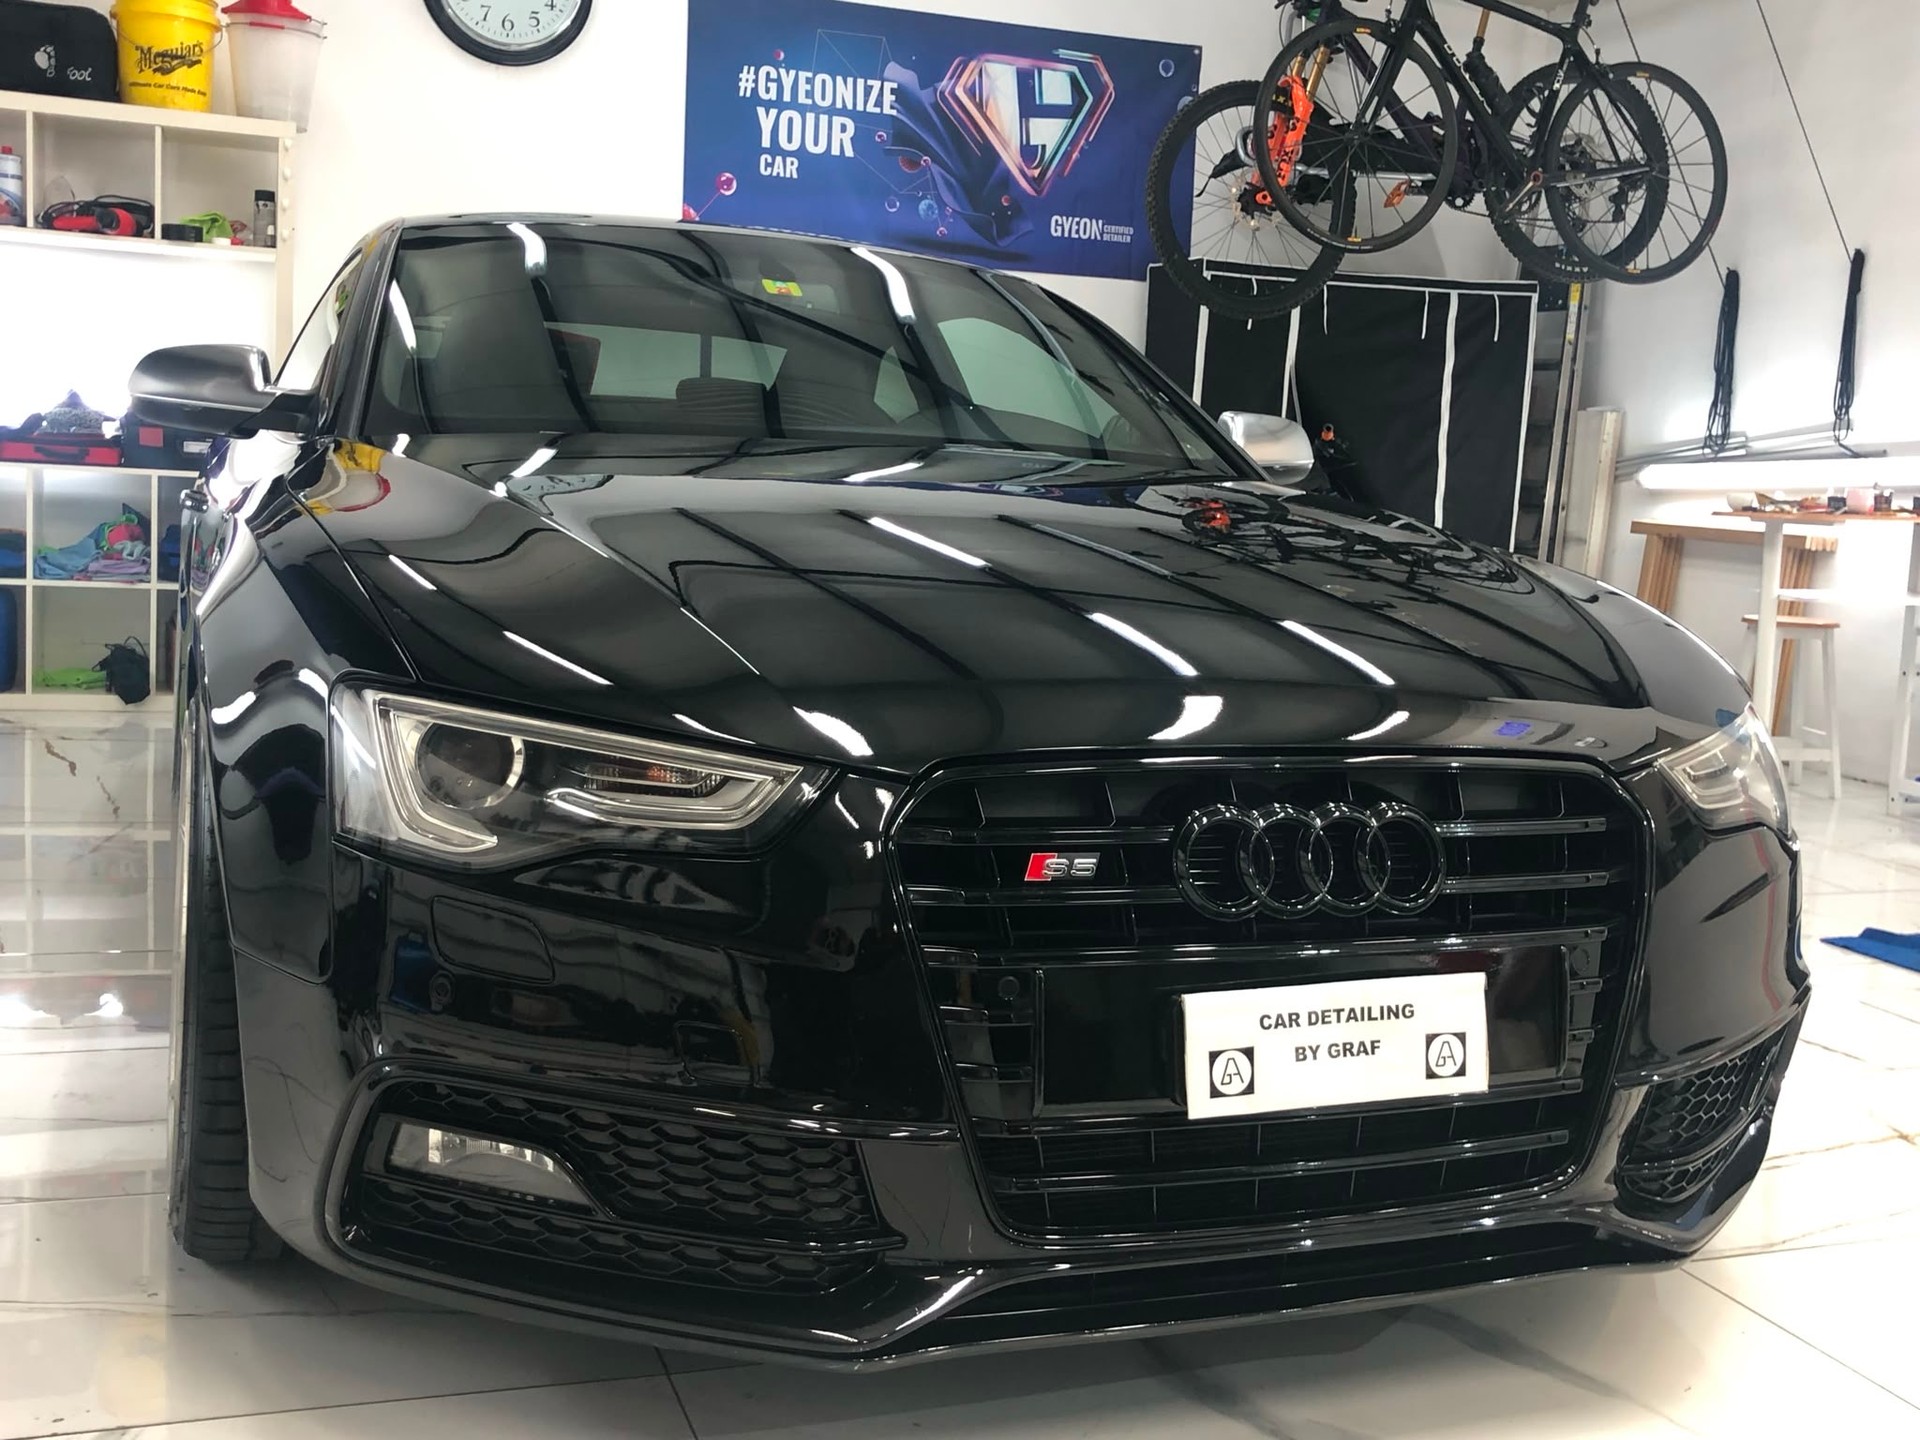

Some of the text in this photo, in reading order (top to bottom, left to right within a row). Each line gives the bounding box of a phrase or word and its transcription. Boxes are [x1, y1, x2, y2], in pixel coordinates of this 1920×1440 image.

[480, 4, 492, 22] 7
[501, 13, 514, 31] 6
[528, 11, 540, 28] 5
[738, 65, 898, 115] #GYEONIZE
[756, 106, 855, 158] YOUR
[759, 153, 799, 179] CAR
[1050, 214, 1103, 241] GYEON
[1042, 858, 1097, 877] S5
[1259, 1003, 1415, 1031] CAR DETAILING
[1295, 1039, 1382, 1063] BY GRAF
